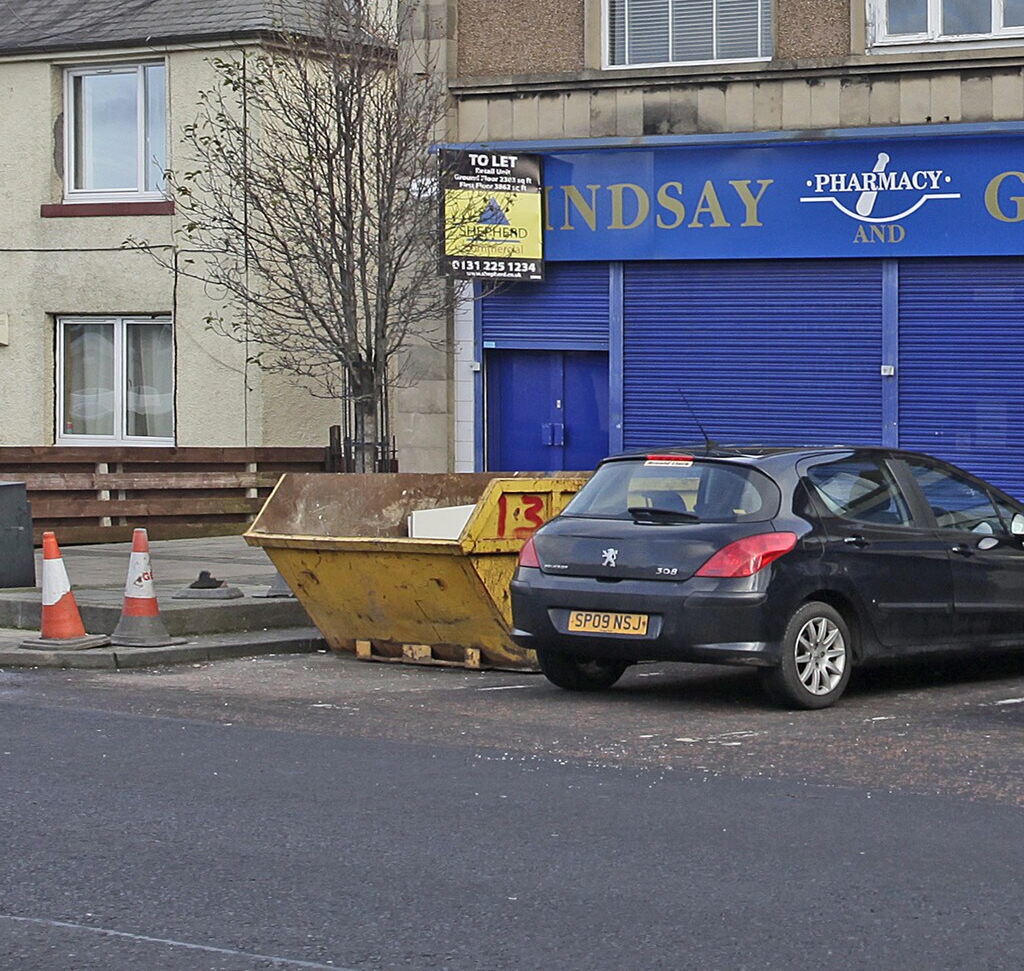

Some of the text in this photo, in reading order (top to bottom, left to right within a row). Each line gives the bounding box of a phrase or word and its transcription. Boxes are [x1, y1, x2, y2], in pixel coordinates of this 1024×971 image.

[468, 154, 518, 168] TO LET
[454, 173, 480, 181] Ground
[814, 170, 943, 193] PHARMACY
[460, 225, 528, 239] SHEPHERD
[853, 224, 906, 244] AND
[452, 260, 536, 273] 0131 225 1234
[498, 494, 544, 538] 13
[655, 567, 678, 576] 308
[575, 613, 642, 630] SP09 NSJ
